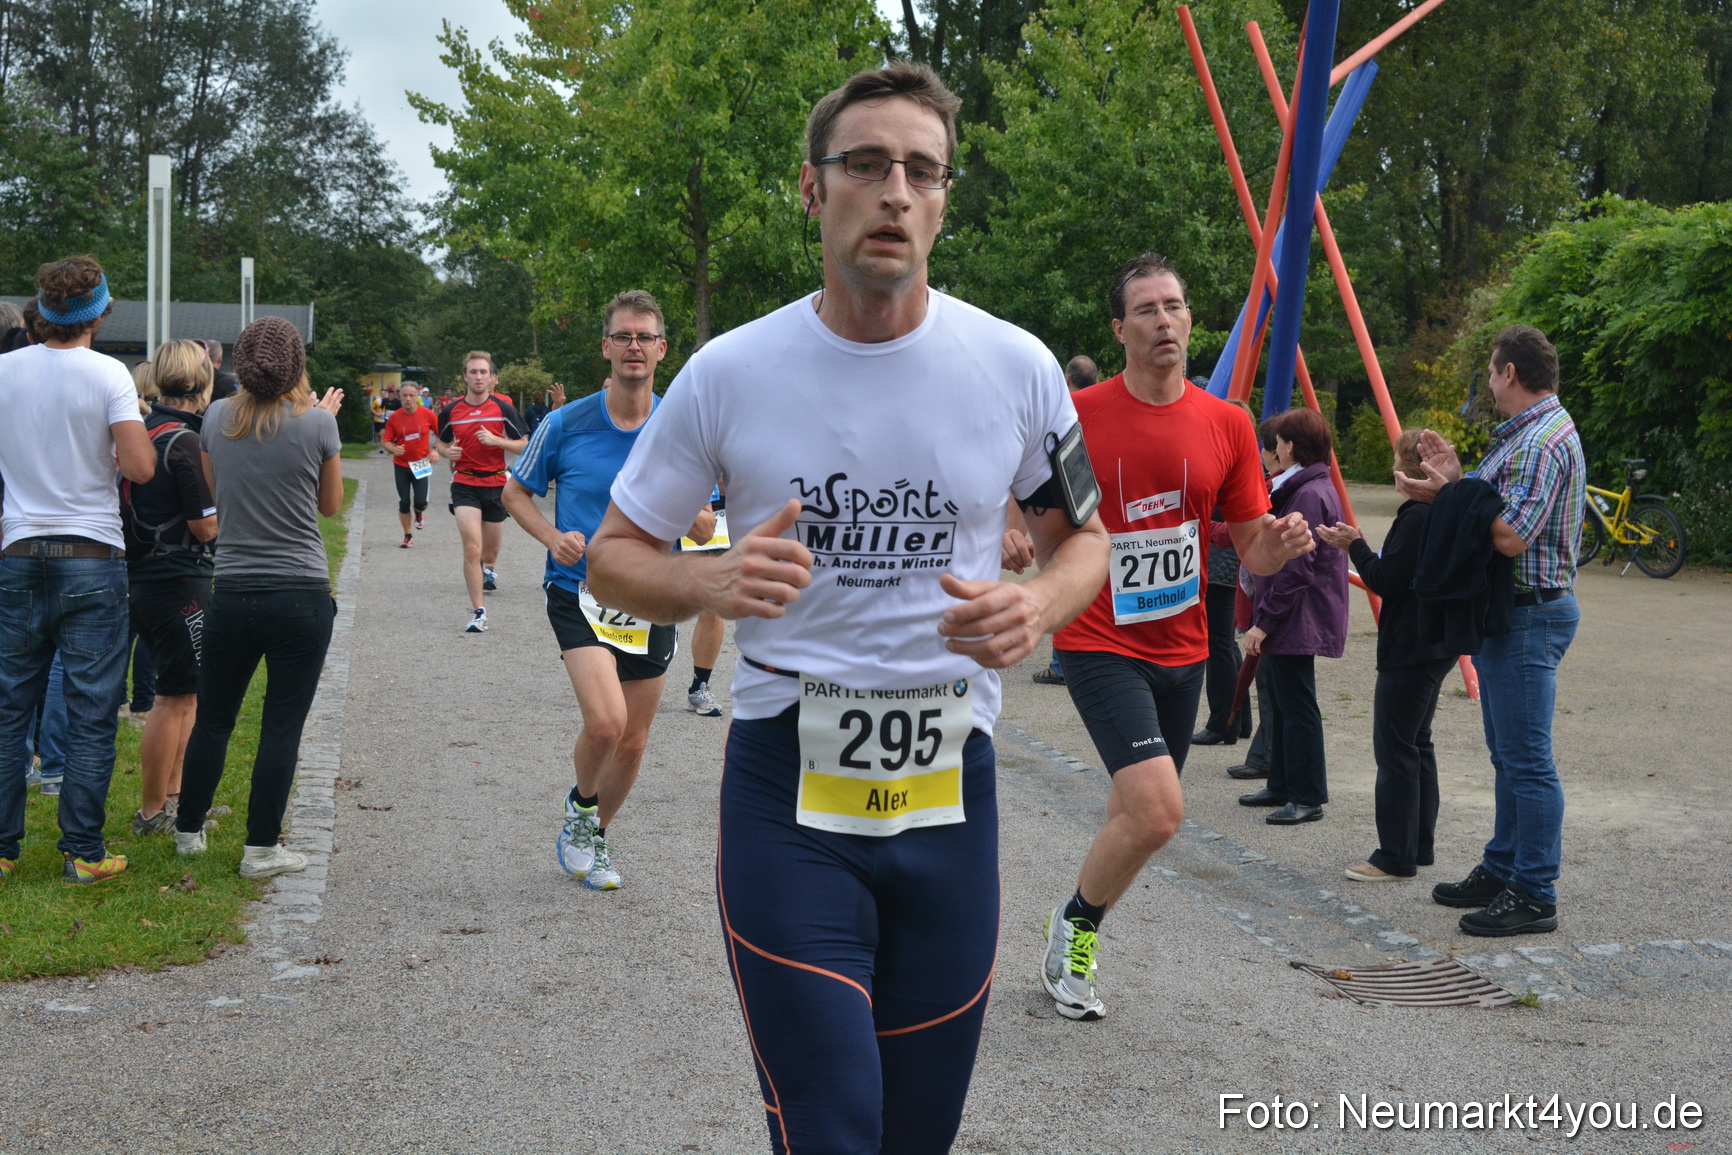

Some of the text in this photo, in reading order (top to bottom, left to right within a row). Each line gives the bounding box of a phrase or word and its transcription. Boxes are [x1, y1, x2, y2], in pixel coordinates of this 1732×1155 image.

[801, 472, 942, 530] Sport
[1142, 498, 1165, 512] DEHN
[806, 525, 948, 552] Müller
[1111, 534, 1188, 551] PARTL Neumarkt
[30, 543, 74, 557] PMA
[831, 556, 896, 570] Andreas
[901, 557, 951, 570] Winter
[1120, 544, 1194, 588] 2702
[836, 575, 902, 588] Neumarkt
[1137, 588, 1186, 610] Berthold
[839, 708, 943, 772] 295
[808, 760, 815, 770] B
[865, 788, 909, 812] Alex
